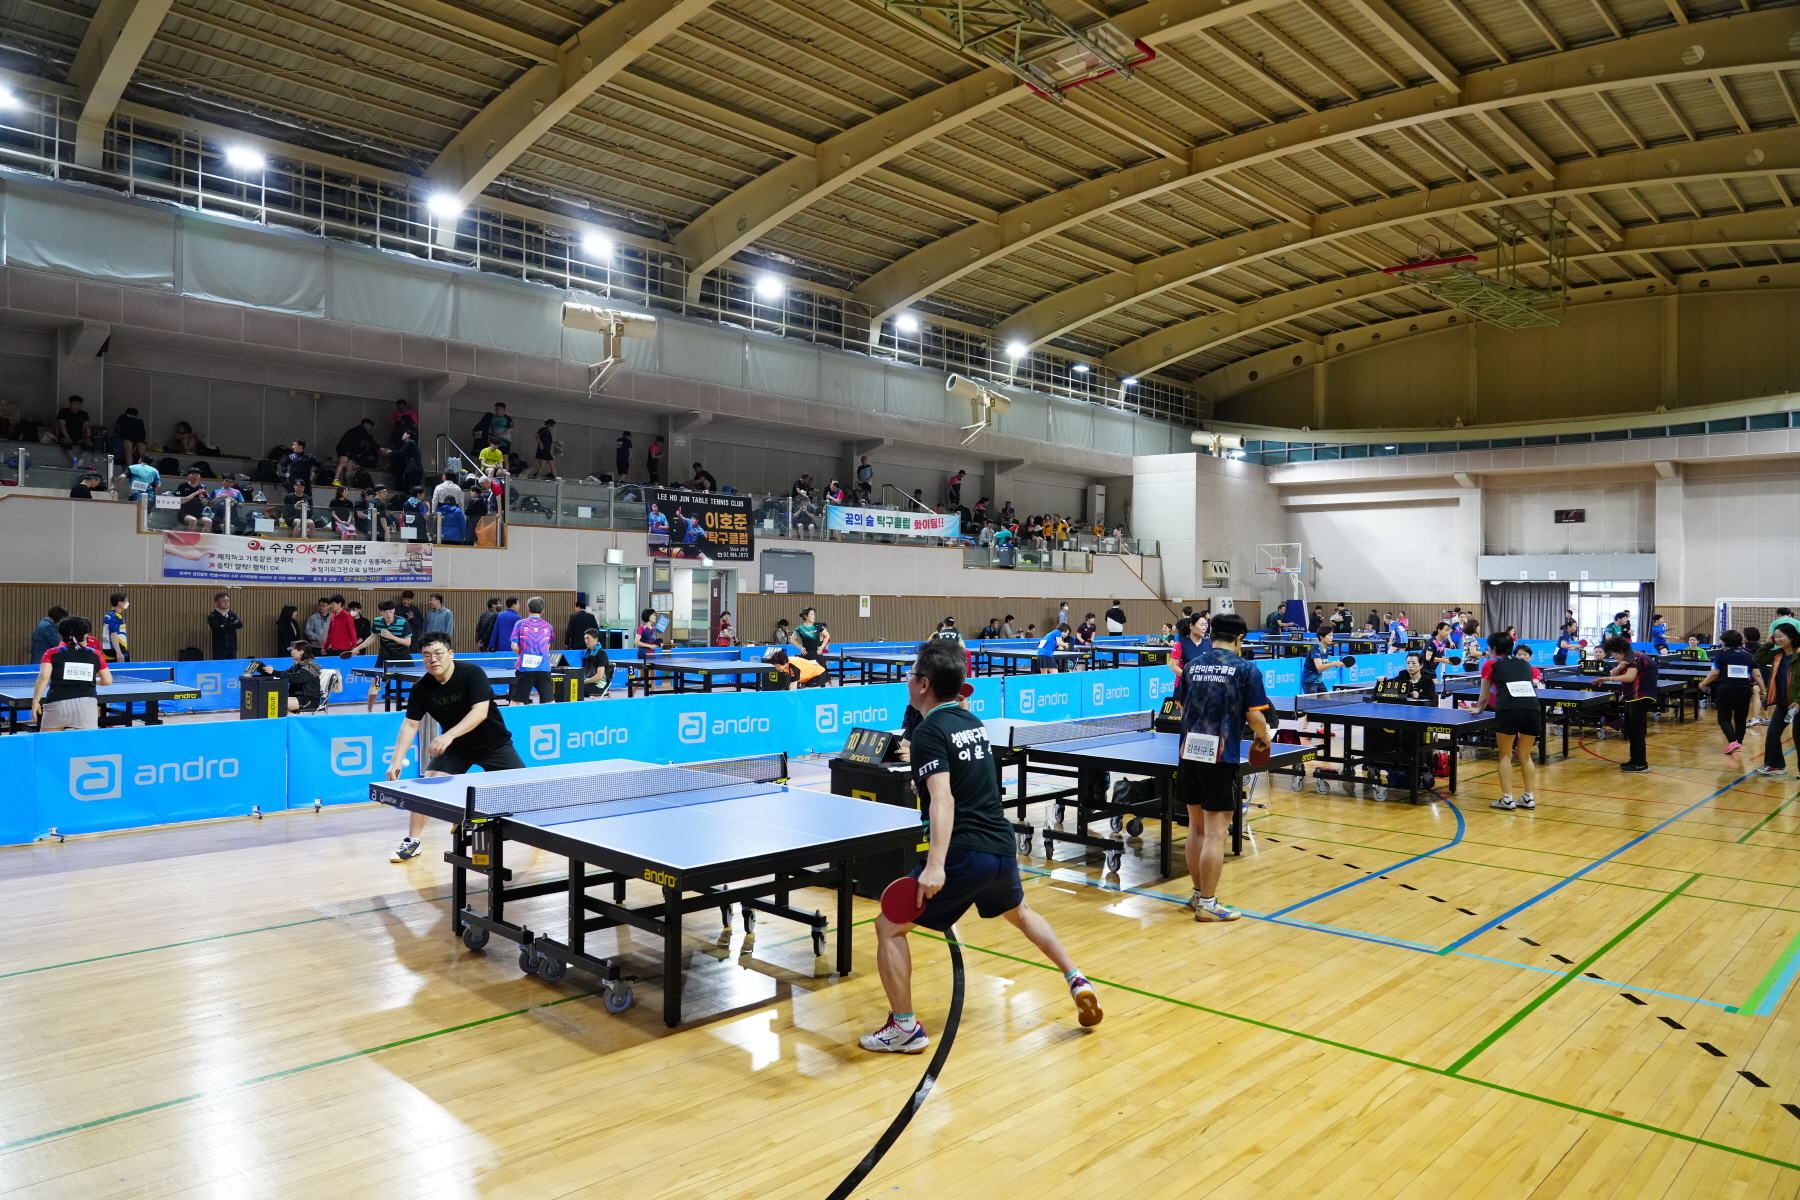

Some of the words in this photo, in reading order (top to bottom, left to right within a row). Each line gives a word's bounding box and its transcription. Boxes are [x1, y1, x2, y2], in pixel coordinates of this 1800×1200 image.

[657, 493, 668, 501] LEE
[669, 494, 678, 502] HO
[680, 495, 690, 503] JUN
[692, 496, 709, 504] TABLE
[710, 498, 729, 506] TENNIS
[730, 500, 744, 508] CLUB
[705, 512, 748, 530] 이호준
[845, 513, 863, 526] 꿈의
[865, 515, 875, 527] 숲
[876, 515, 910, 529] 탁구클럽
[913, 518, 945, 530] 화이팅!!
[708, 531, 749, 545] 탁구클럽
[269, 543, 367, 555] 수유OK탁구클럽
[1192, 674, 1203, 682] KIM
[1203, 675, 1227, 683] HYUNGU
[1276, 672, 1295, 683] andro
[1359, 667, 1376, 677] andro
[1105, 686, 1130, 699] andro
[1400, 682, 1407, 693] 5
[173, 692, 198, 700] andro
[1037, 692, 1068, 706] andro
[1163, 701, 1174, 714] 10
[842, 706, 888, 725] andro
[712, 715, 770, 735] andro
[1427, 726, 1451, 734] andro
[566, 726, 629, 749] andro
[847, 732, 861, 750] 10
[875, 736, 886, 755] 5
[1208, 748, 1215, 757] 5
[134, 756, 239, 786] andro
[919, 759, 940, 777] ETTF
[643, 868, 675, 888] andro
